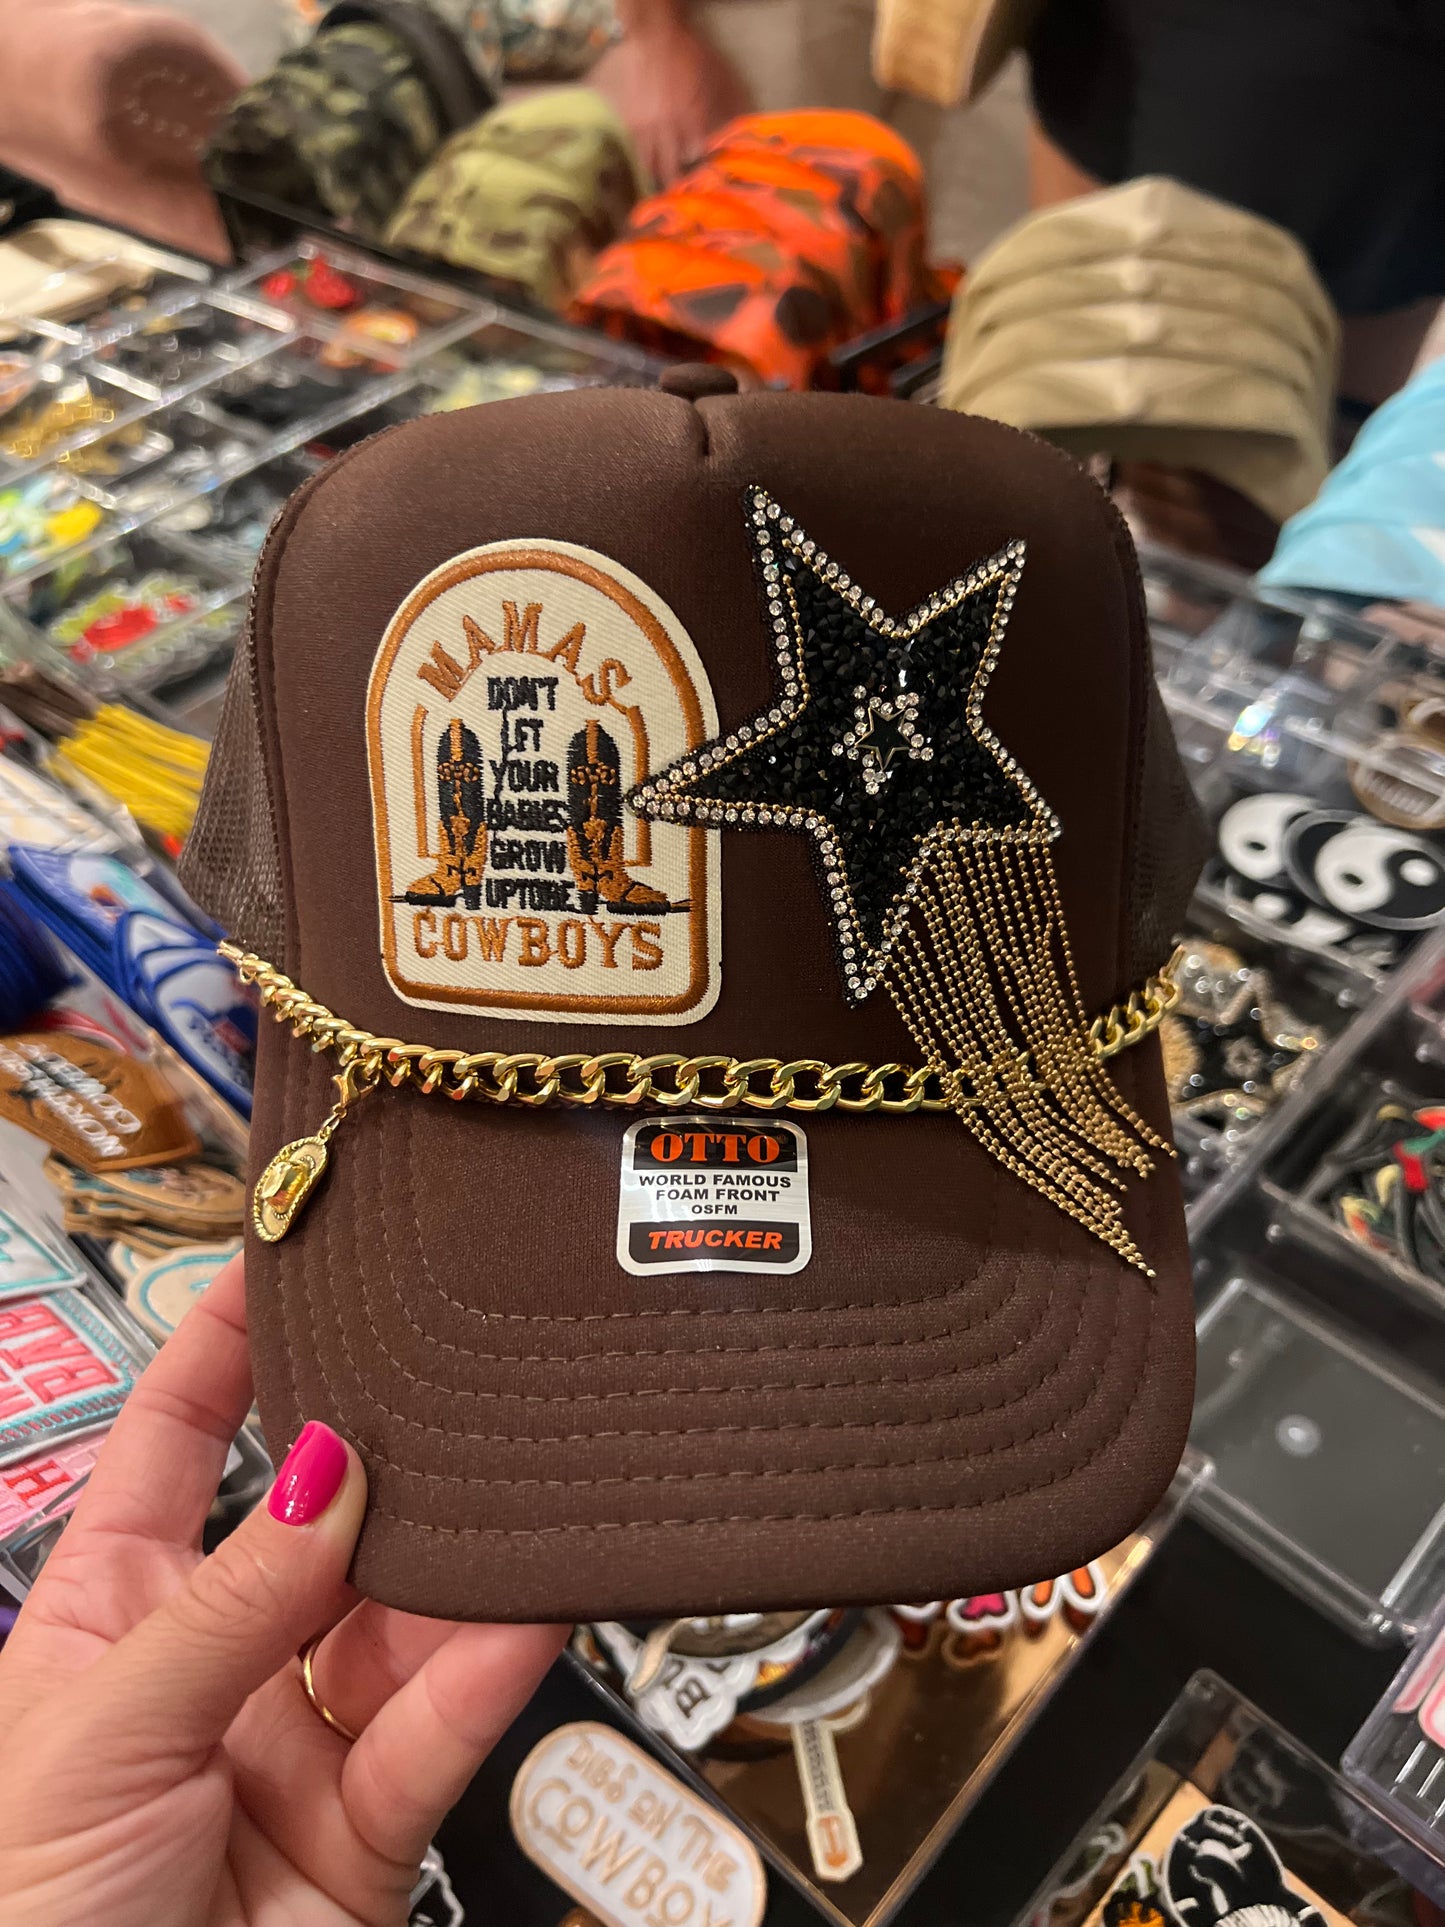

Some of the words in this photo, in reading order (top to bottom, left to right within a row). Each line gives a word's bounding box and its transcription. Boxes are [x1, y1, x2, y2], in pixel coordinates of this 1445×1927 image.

[417, 600, 632, 706] MAMAS
[488, 759, 560, 793] YOUR
[486, 798, 570, 833] BABIES
[490, 838, 567, 874] GROW
[413, 911, 665, 972] COWBOYS
[650, 1132, 780, 1163] OTTO
[639, 1174, 707, 1186] WORLD
[713, 1174, 792, 1188] FAMOUS
[656, 1188, 709, 1201] FOAM
[715, 1189, 780, 1202] FRONT
[691, 1204, 738, 1215] OSFM
[648, 1229, 783, 1250] TRUCKER
[565, 1732, 638, 1801] DIBS
[627, 1790, 683, 1841] ON
[678, 1814, 740, 1894] THE
